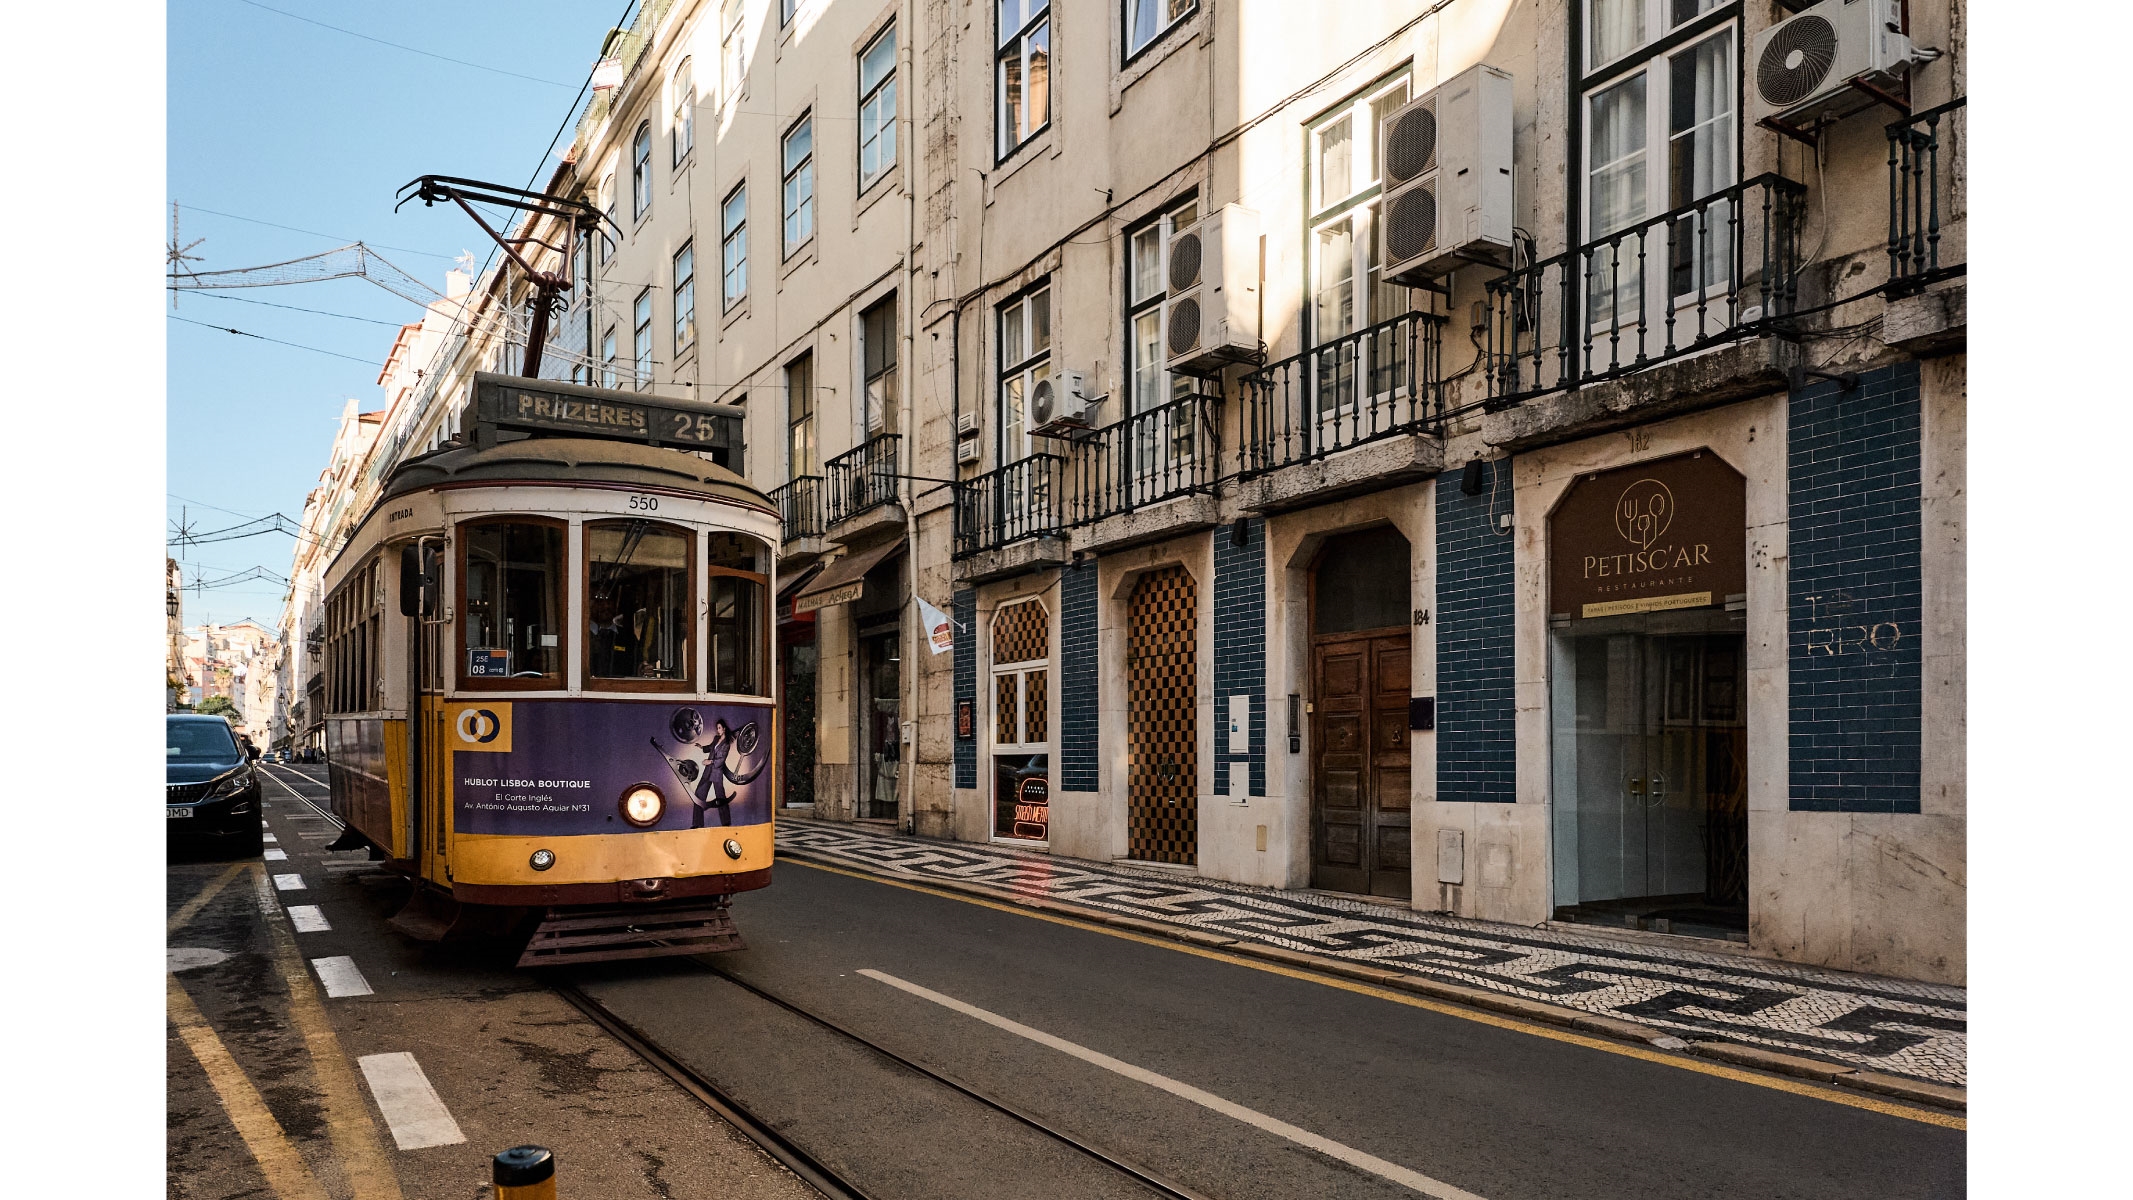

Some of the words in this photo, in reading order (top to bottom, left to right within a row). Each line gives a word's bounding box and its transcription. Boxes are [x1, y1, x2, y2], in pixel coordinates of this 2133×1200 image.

[518, 394, 646, 428] PRAZERES
[674, 412, 717, 441] 25
[1630, 433, 1650, 453] 182
[629, 495, 658, 511] 550
[1583, 543, 1712, 579] PETISC'AR
[1597, 576, 1693, 593] RESTAURANTE
[1663, 597, 1707, 607] PORTUGUESES
[1413, 608, 1430, 626] 184
[475, 655, 489, 663] 25E
[472, 664, 486, 674] 08
[464, 778, 498, 787] HUBLOT
[500, 779, 536, 788] LISBOA
[538, 780, 591, 789] BOUTIQUE
[495, 793, 502, 801] El
[504, 793, 527, 801] Corte
[528, 793, 553, 803] Inglés
[476, 802, 505, 810] António
[506, 803, 541, 812] Augusto
[542, 804, 569, 813] Aguiar
